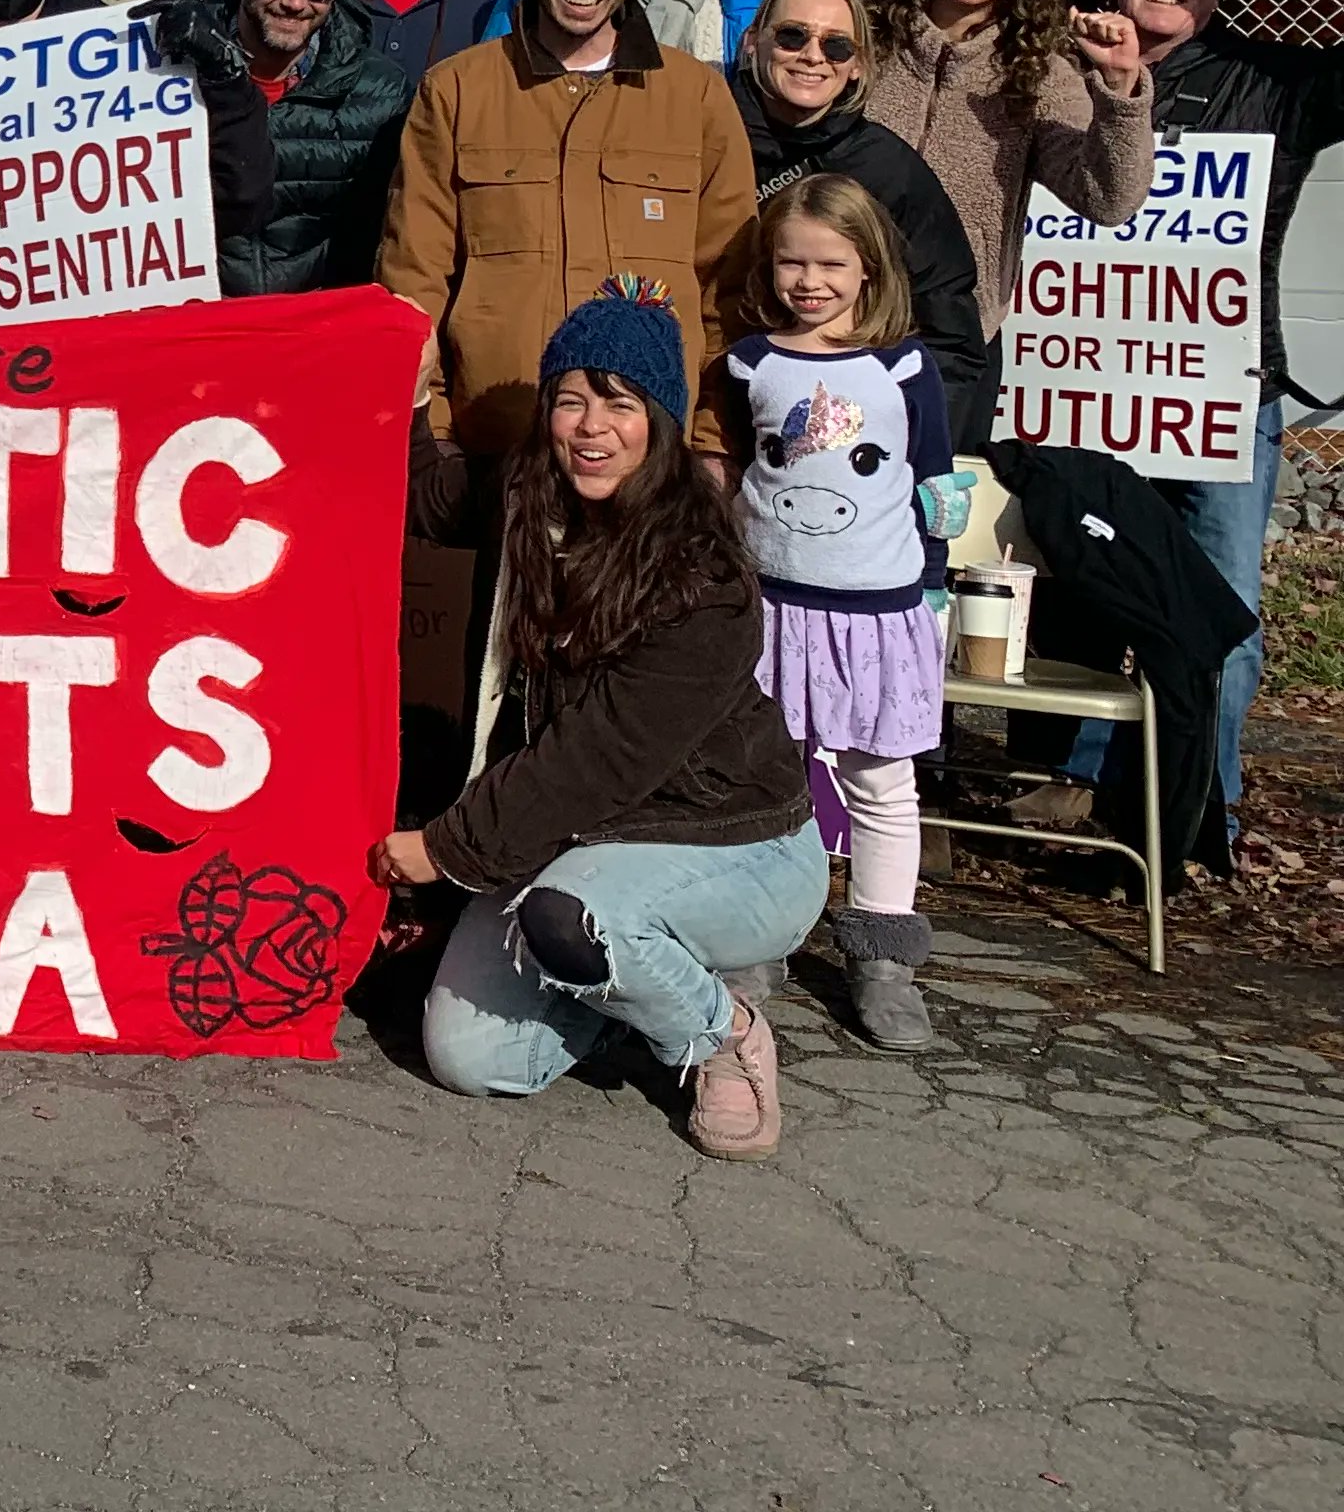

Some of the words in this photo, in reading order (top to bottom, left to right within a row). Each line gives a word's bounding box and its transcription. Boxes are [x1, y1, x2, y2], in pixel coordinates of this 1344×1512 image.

[53, 76, 193, 132] 374-G
[1113, 208, 1249, 245] 374-G
[1013, 259, 1249, 327] IGHTING
[1015, 333, 1102, 372] FOR
[1117, 338, 1206, 379] THE
